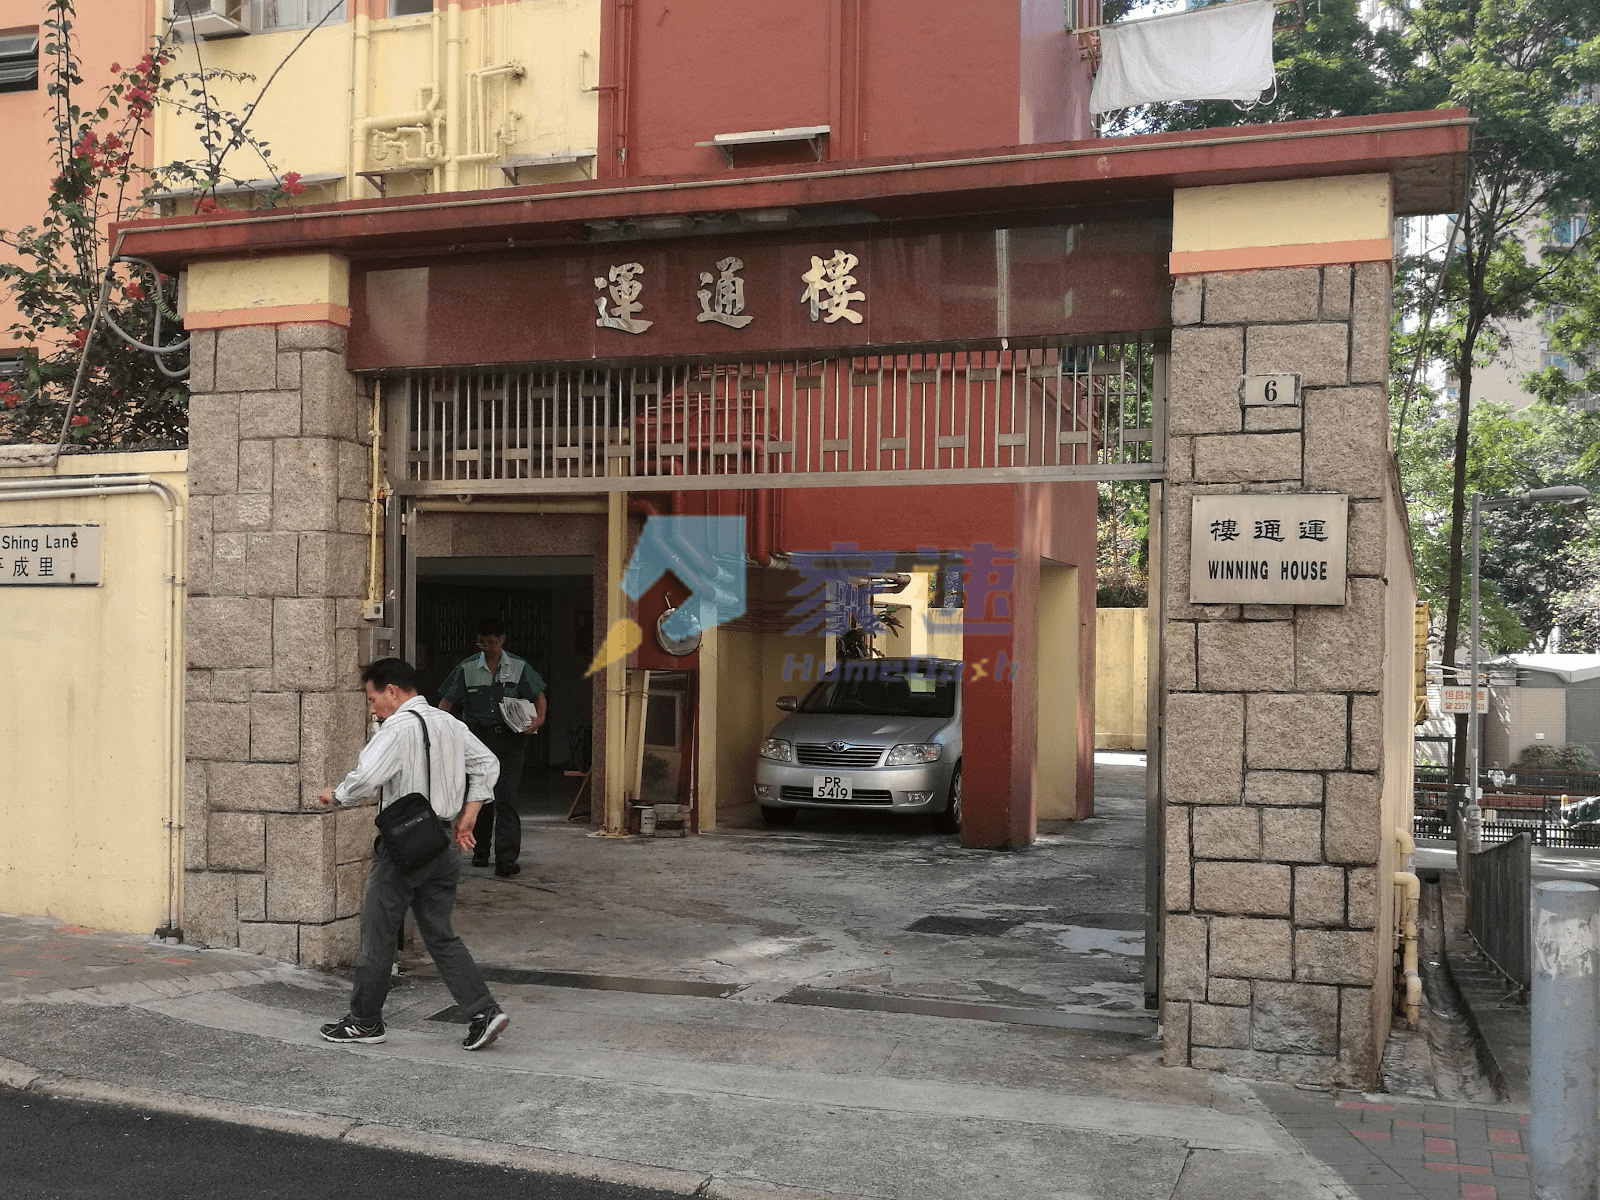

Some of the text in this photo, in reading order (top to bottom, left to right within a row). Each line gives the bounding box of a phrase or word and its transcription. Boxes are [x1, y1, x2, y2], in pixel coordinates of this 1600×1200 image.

[594, 249, 866, 334] 運通樓
[1264, 380, 1278, 402] 6
[2, 534, 79, 552] Shing Lane
[0, 556, 54, 577] 成里
[1208, 560, 1328, 581] WINNING HOUSE
[817, 786, 848, 799] 5419
[824, 776, 841, 788] PR
